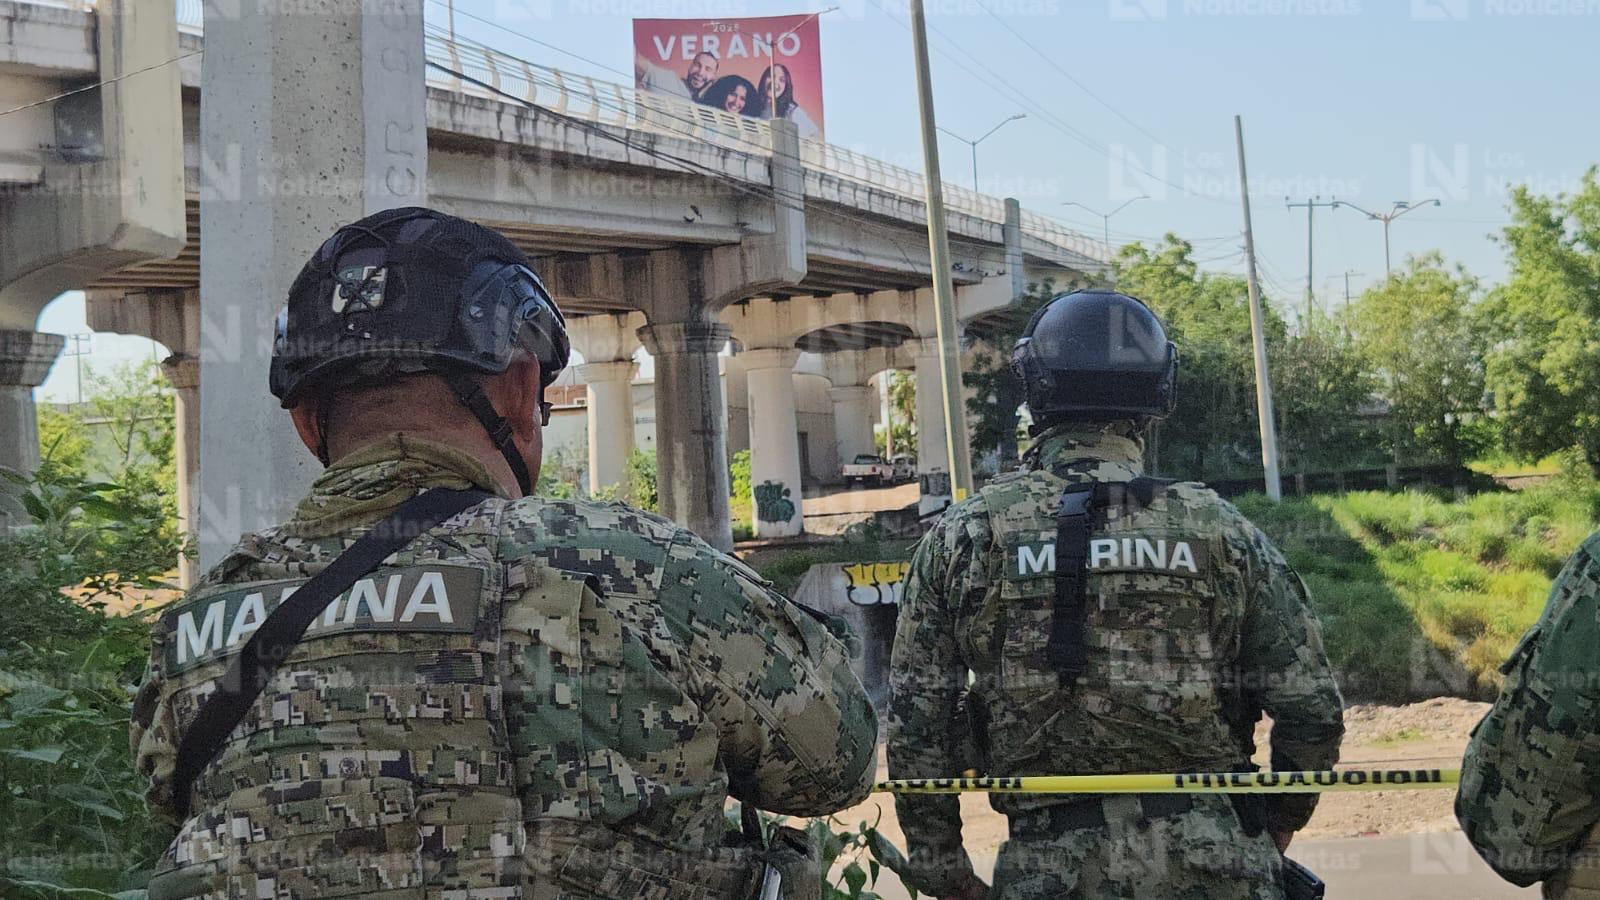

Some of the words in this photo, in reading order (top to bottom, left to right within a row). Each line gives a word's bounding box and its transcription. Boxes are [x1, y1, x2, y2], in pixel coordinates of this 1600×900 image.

[653, 32, 801, 61] VERANO
[1018, 538, 1198, 575] MRINA
[177, 572, 454, 664] MAINA
